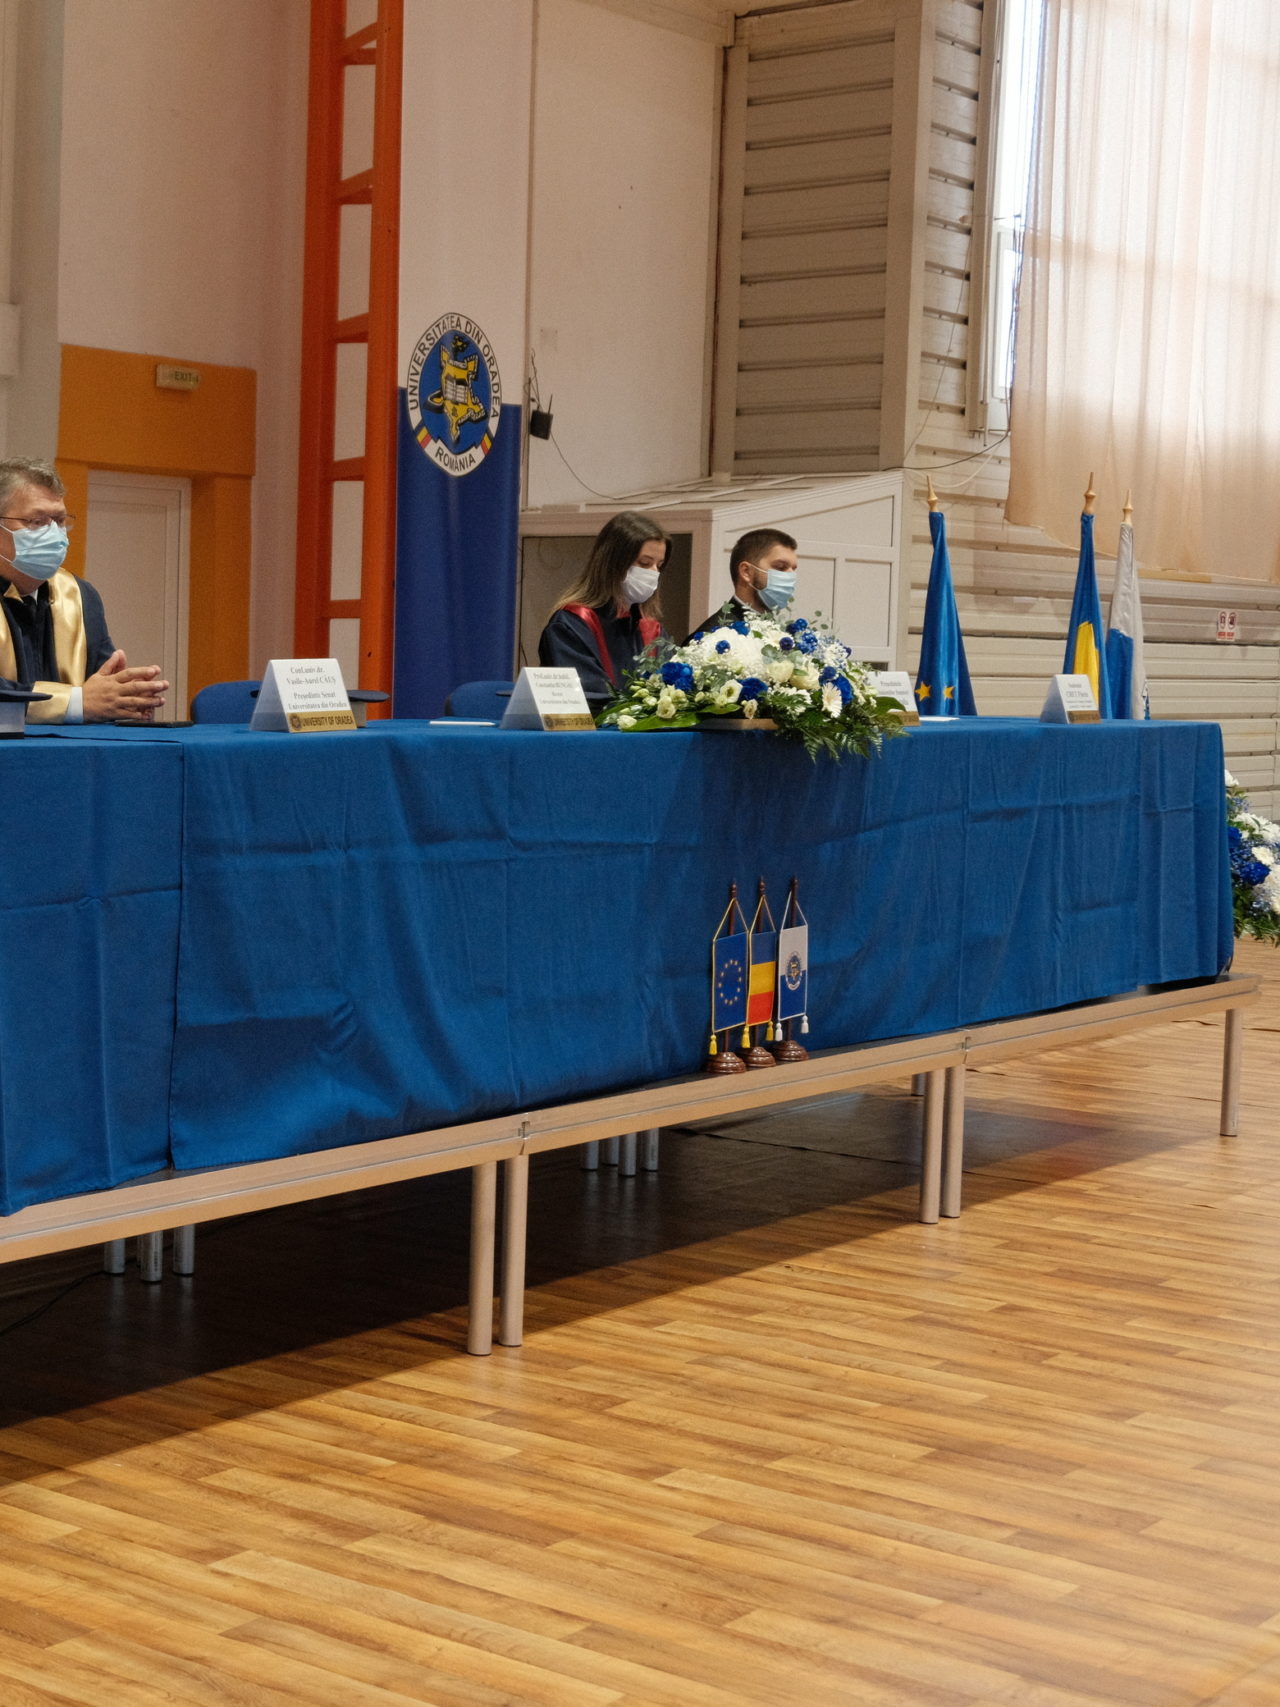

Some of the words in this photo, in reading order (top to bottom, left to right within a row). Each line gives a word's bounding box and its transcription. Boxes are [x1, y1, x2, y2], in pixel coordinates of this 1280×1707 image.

[408, 315, 462, 411] UNIVERSITATEA
[464, 321, 483, 344] DIN
[482, 344, 501, 418] ORADEA
[302, 716, 328, 727] UNIVERSITY
[328, 716, 335, 725] OF
[334, 715, 354, 725] ORADEA
